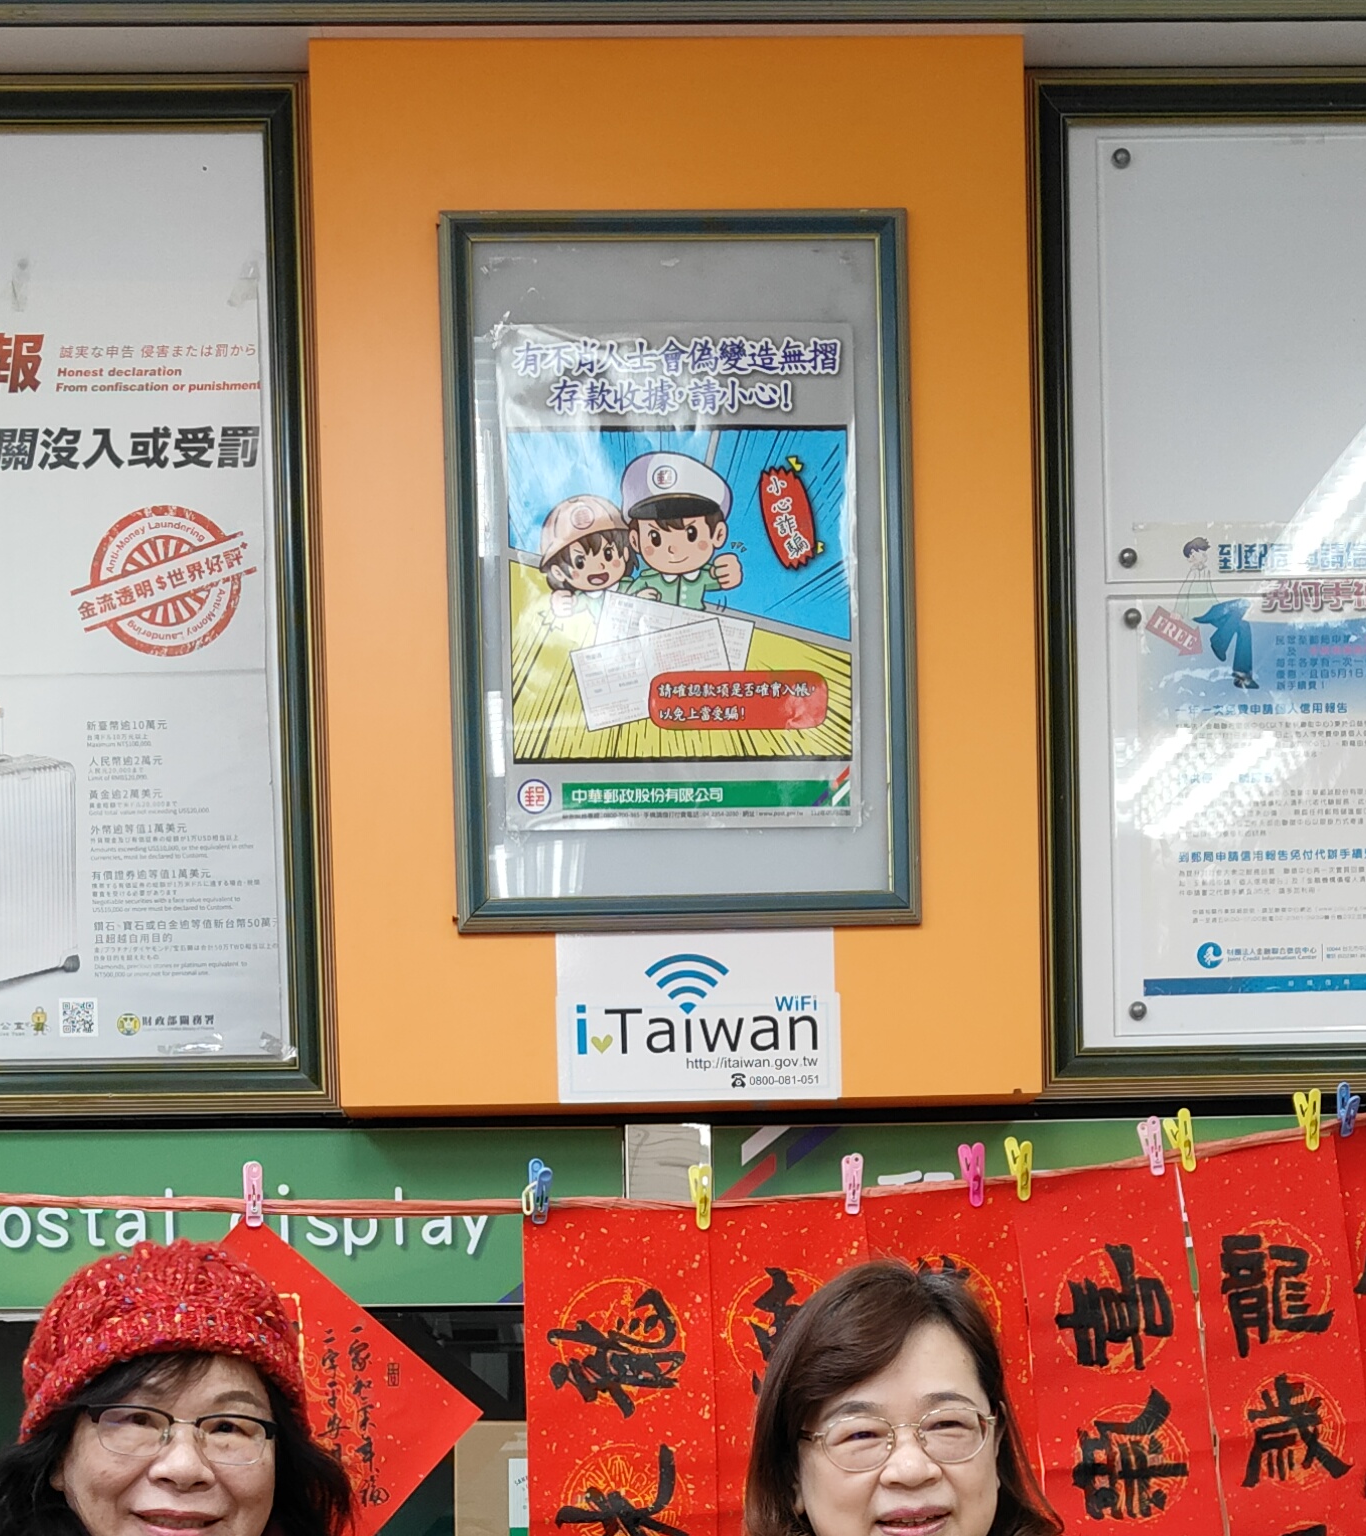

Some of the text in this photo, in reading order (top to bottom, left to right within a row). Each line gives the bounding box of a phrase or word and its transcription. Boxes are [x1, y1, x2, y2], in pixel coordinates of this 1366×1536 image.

[513, 337, 840, 376] 有不肖人士會偽變造無摺
[56, 365, 183, 378] Honest declaration
[55, 379, 260, 394] From confiscation or punishment
[766, 474, 811, 559] 小心詐騙
[1151, 614, 1198, 652] FREE
[571, 786, 724, 805] 中華郵政股份有限公司
[774, 994, 818, 1012] WiFi
[686, 1056, 819, 1070] http://itaiwan.gov.tw
[749, 1074, 820, 1087] 0800-081-051
[231, 1185, 493, 1256] isplay
